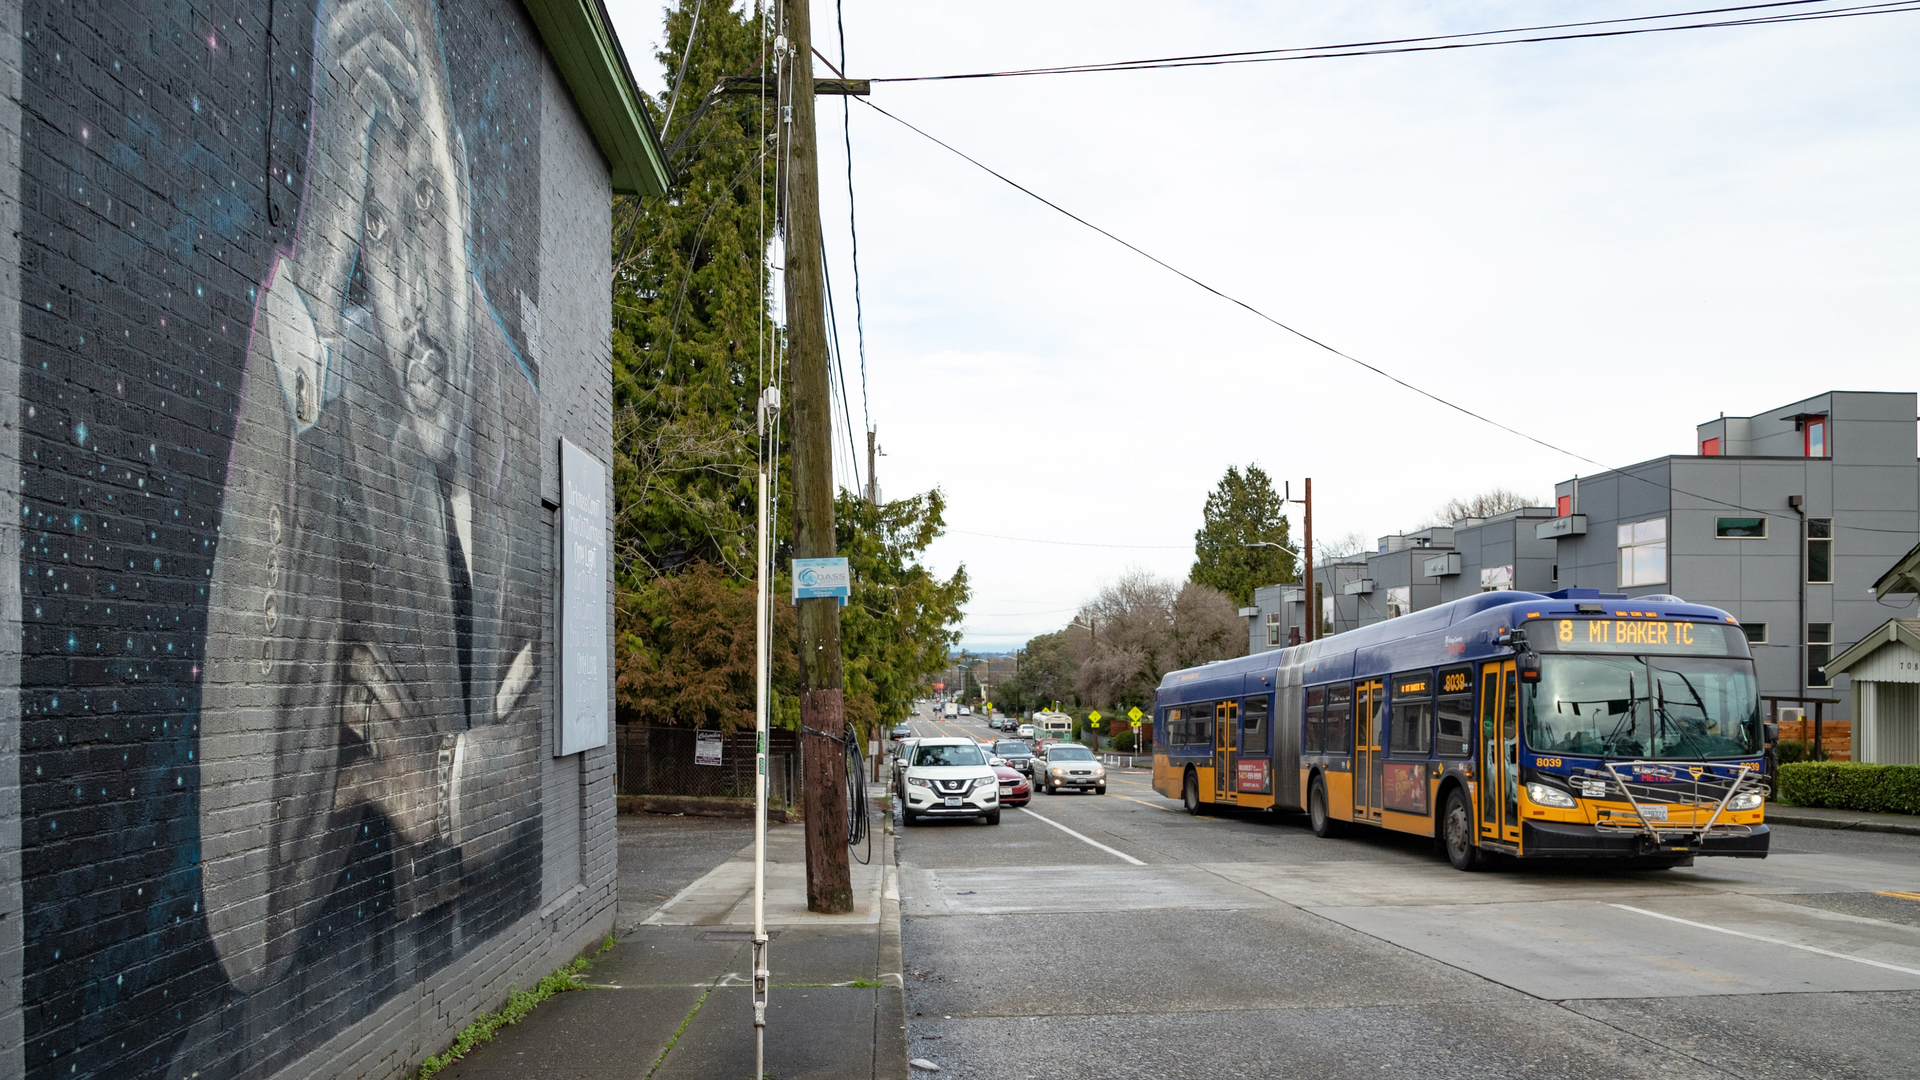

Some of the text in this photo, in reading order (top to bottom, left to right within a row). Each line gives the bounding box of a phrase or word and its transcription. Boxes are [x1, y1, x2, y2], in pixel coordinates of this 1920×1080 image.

[1559, 619, 1694, 645] 8 MT BAKER TC
[1900, 662, 1919, 671] 708
[1445, 673, 1465, 692] 8039
[1536, 757, 1562, 767] 8039
[1641, 773, 1672, 782] METRO
